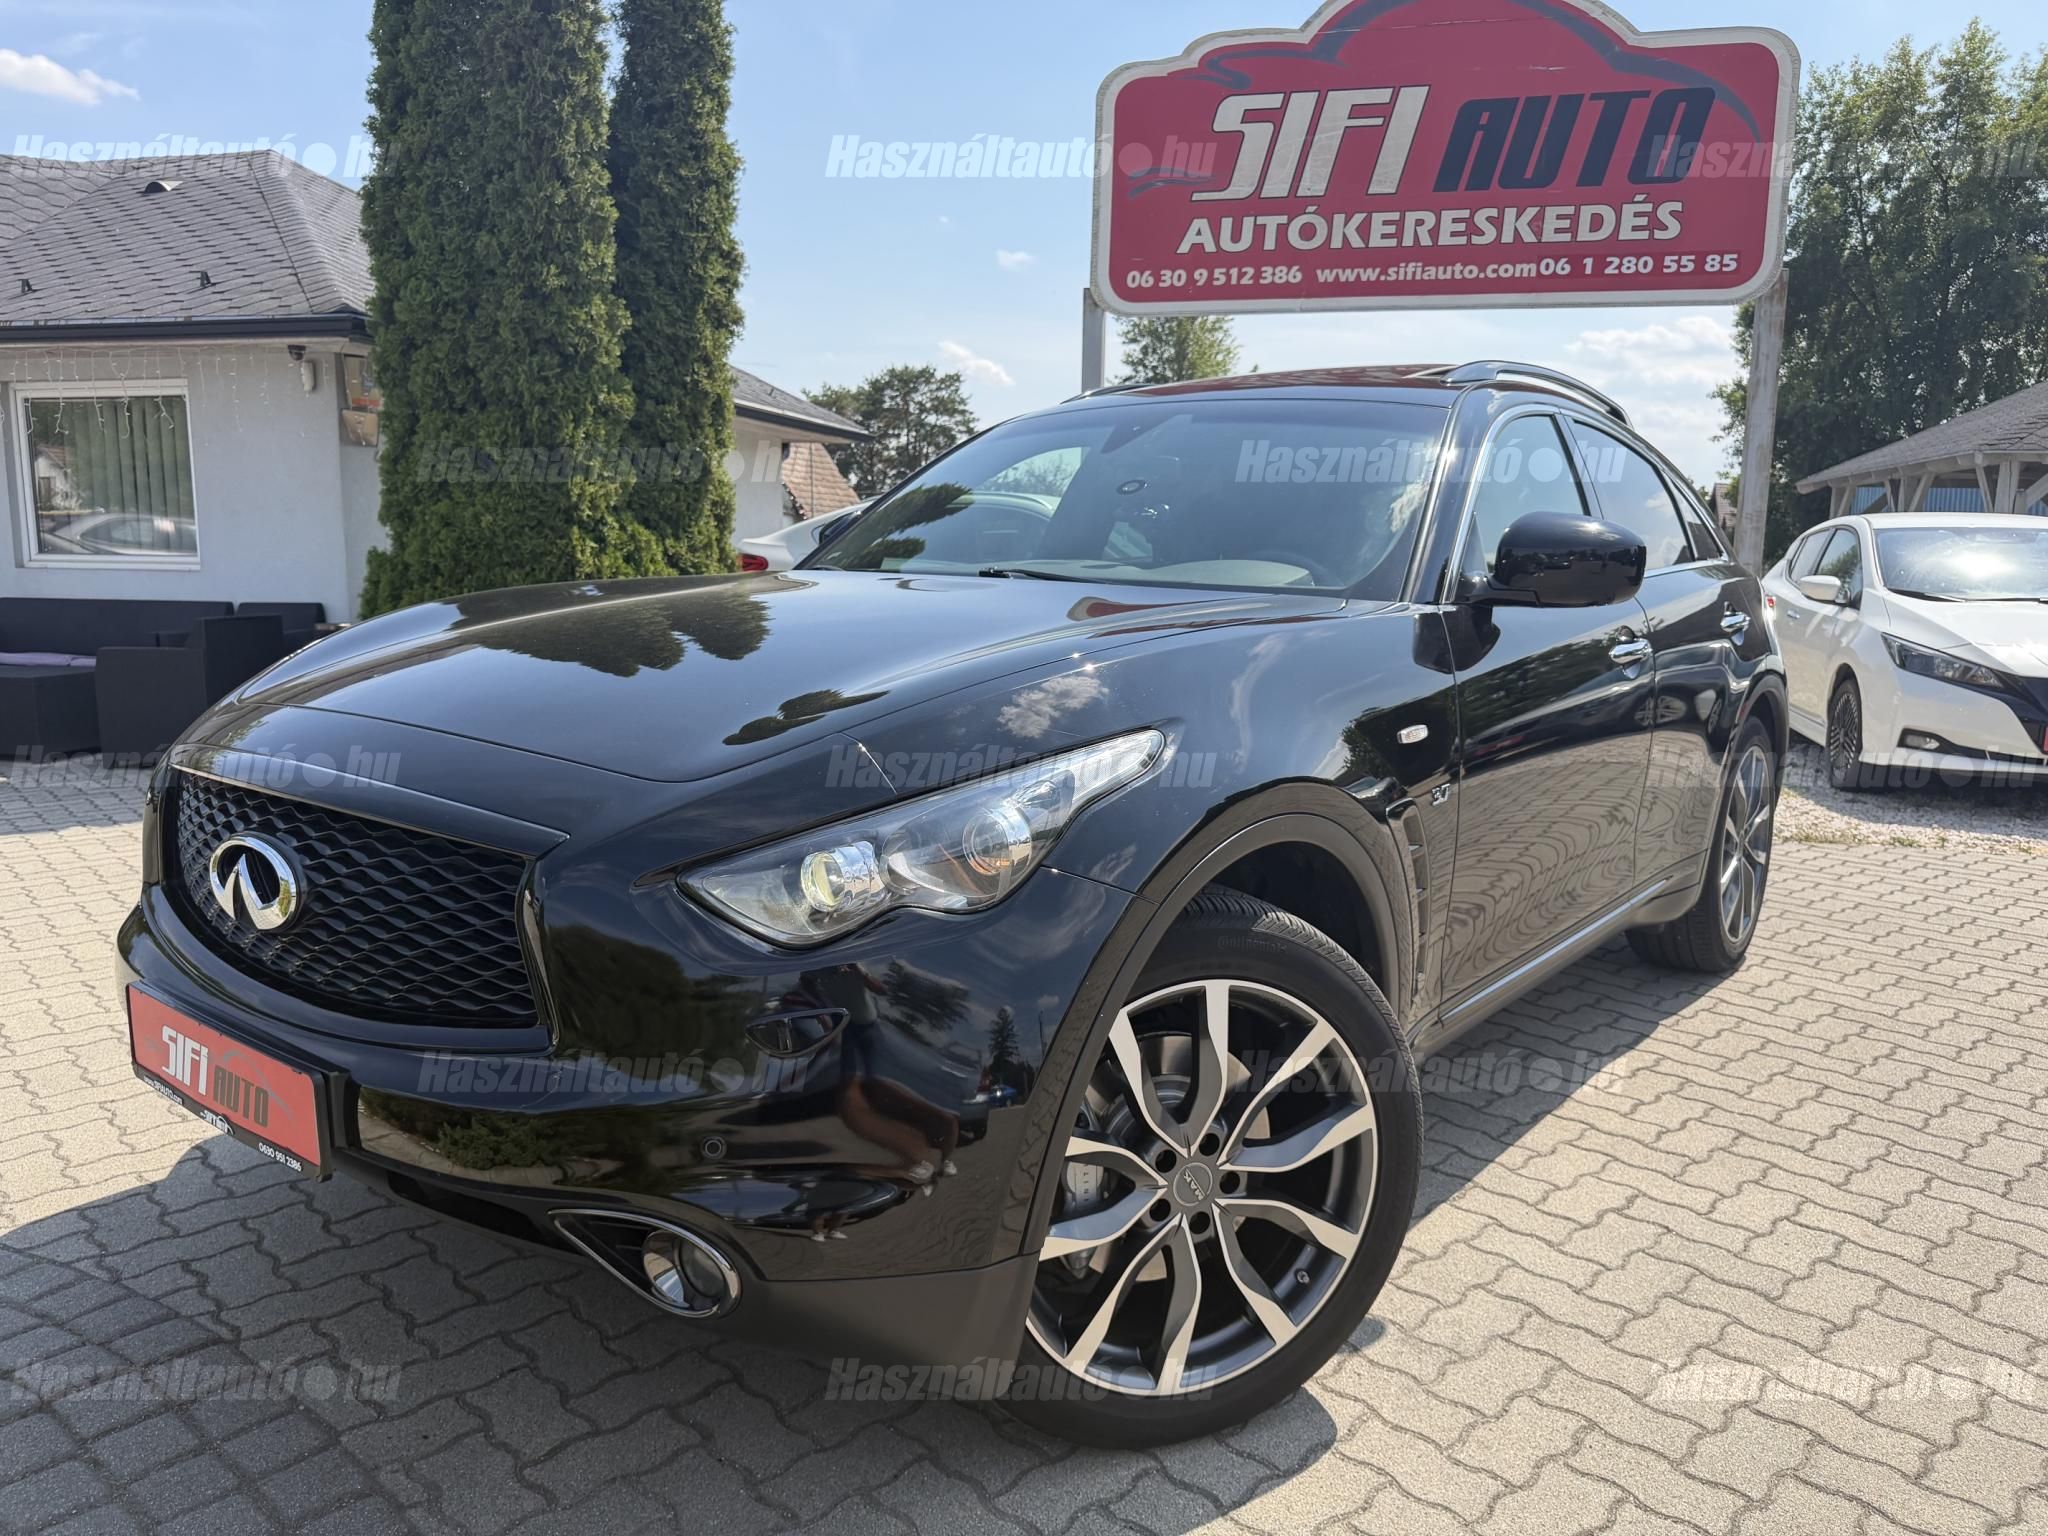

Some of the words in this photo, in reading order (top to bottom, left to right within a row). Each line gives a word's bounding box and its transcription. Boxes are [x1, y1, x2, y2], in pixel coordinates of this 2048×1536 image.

[1191, 84, 1431, 202] SIFI
[1432, 86, 1716, 194] AUTO
[1176, 194, 1684, 255] AUTÓKERESKEDÉS
[1126, 270, 1154, 289] 06
[1159, 269, 1187, 288] 30
[1193, 268, 1208, 287] 9
[1212, 267, 1255, 286] 512
[1259, 265, 1303, 285] 386
[1316, 261, 1537, 283] www.sifiauto.com
[1539, 257, 1571, 276] 06
[1582, 257, 1595, 275] 1
[1604, 255, 1654, 275] 280
[1662, 255, 1696, 273] 55
[1704, 253, 1738, 273] 85
[161, 1024, 209, 1097] SIFI
[212, 1064, 270, 1129] AUTO
[258, 1142, 275, 1158] 0630
